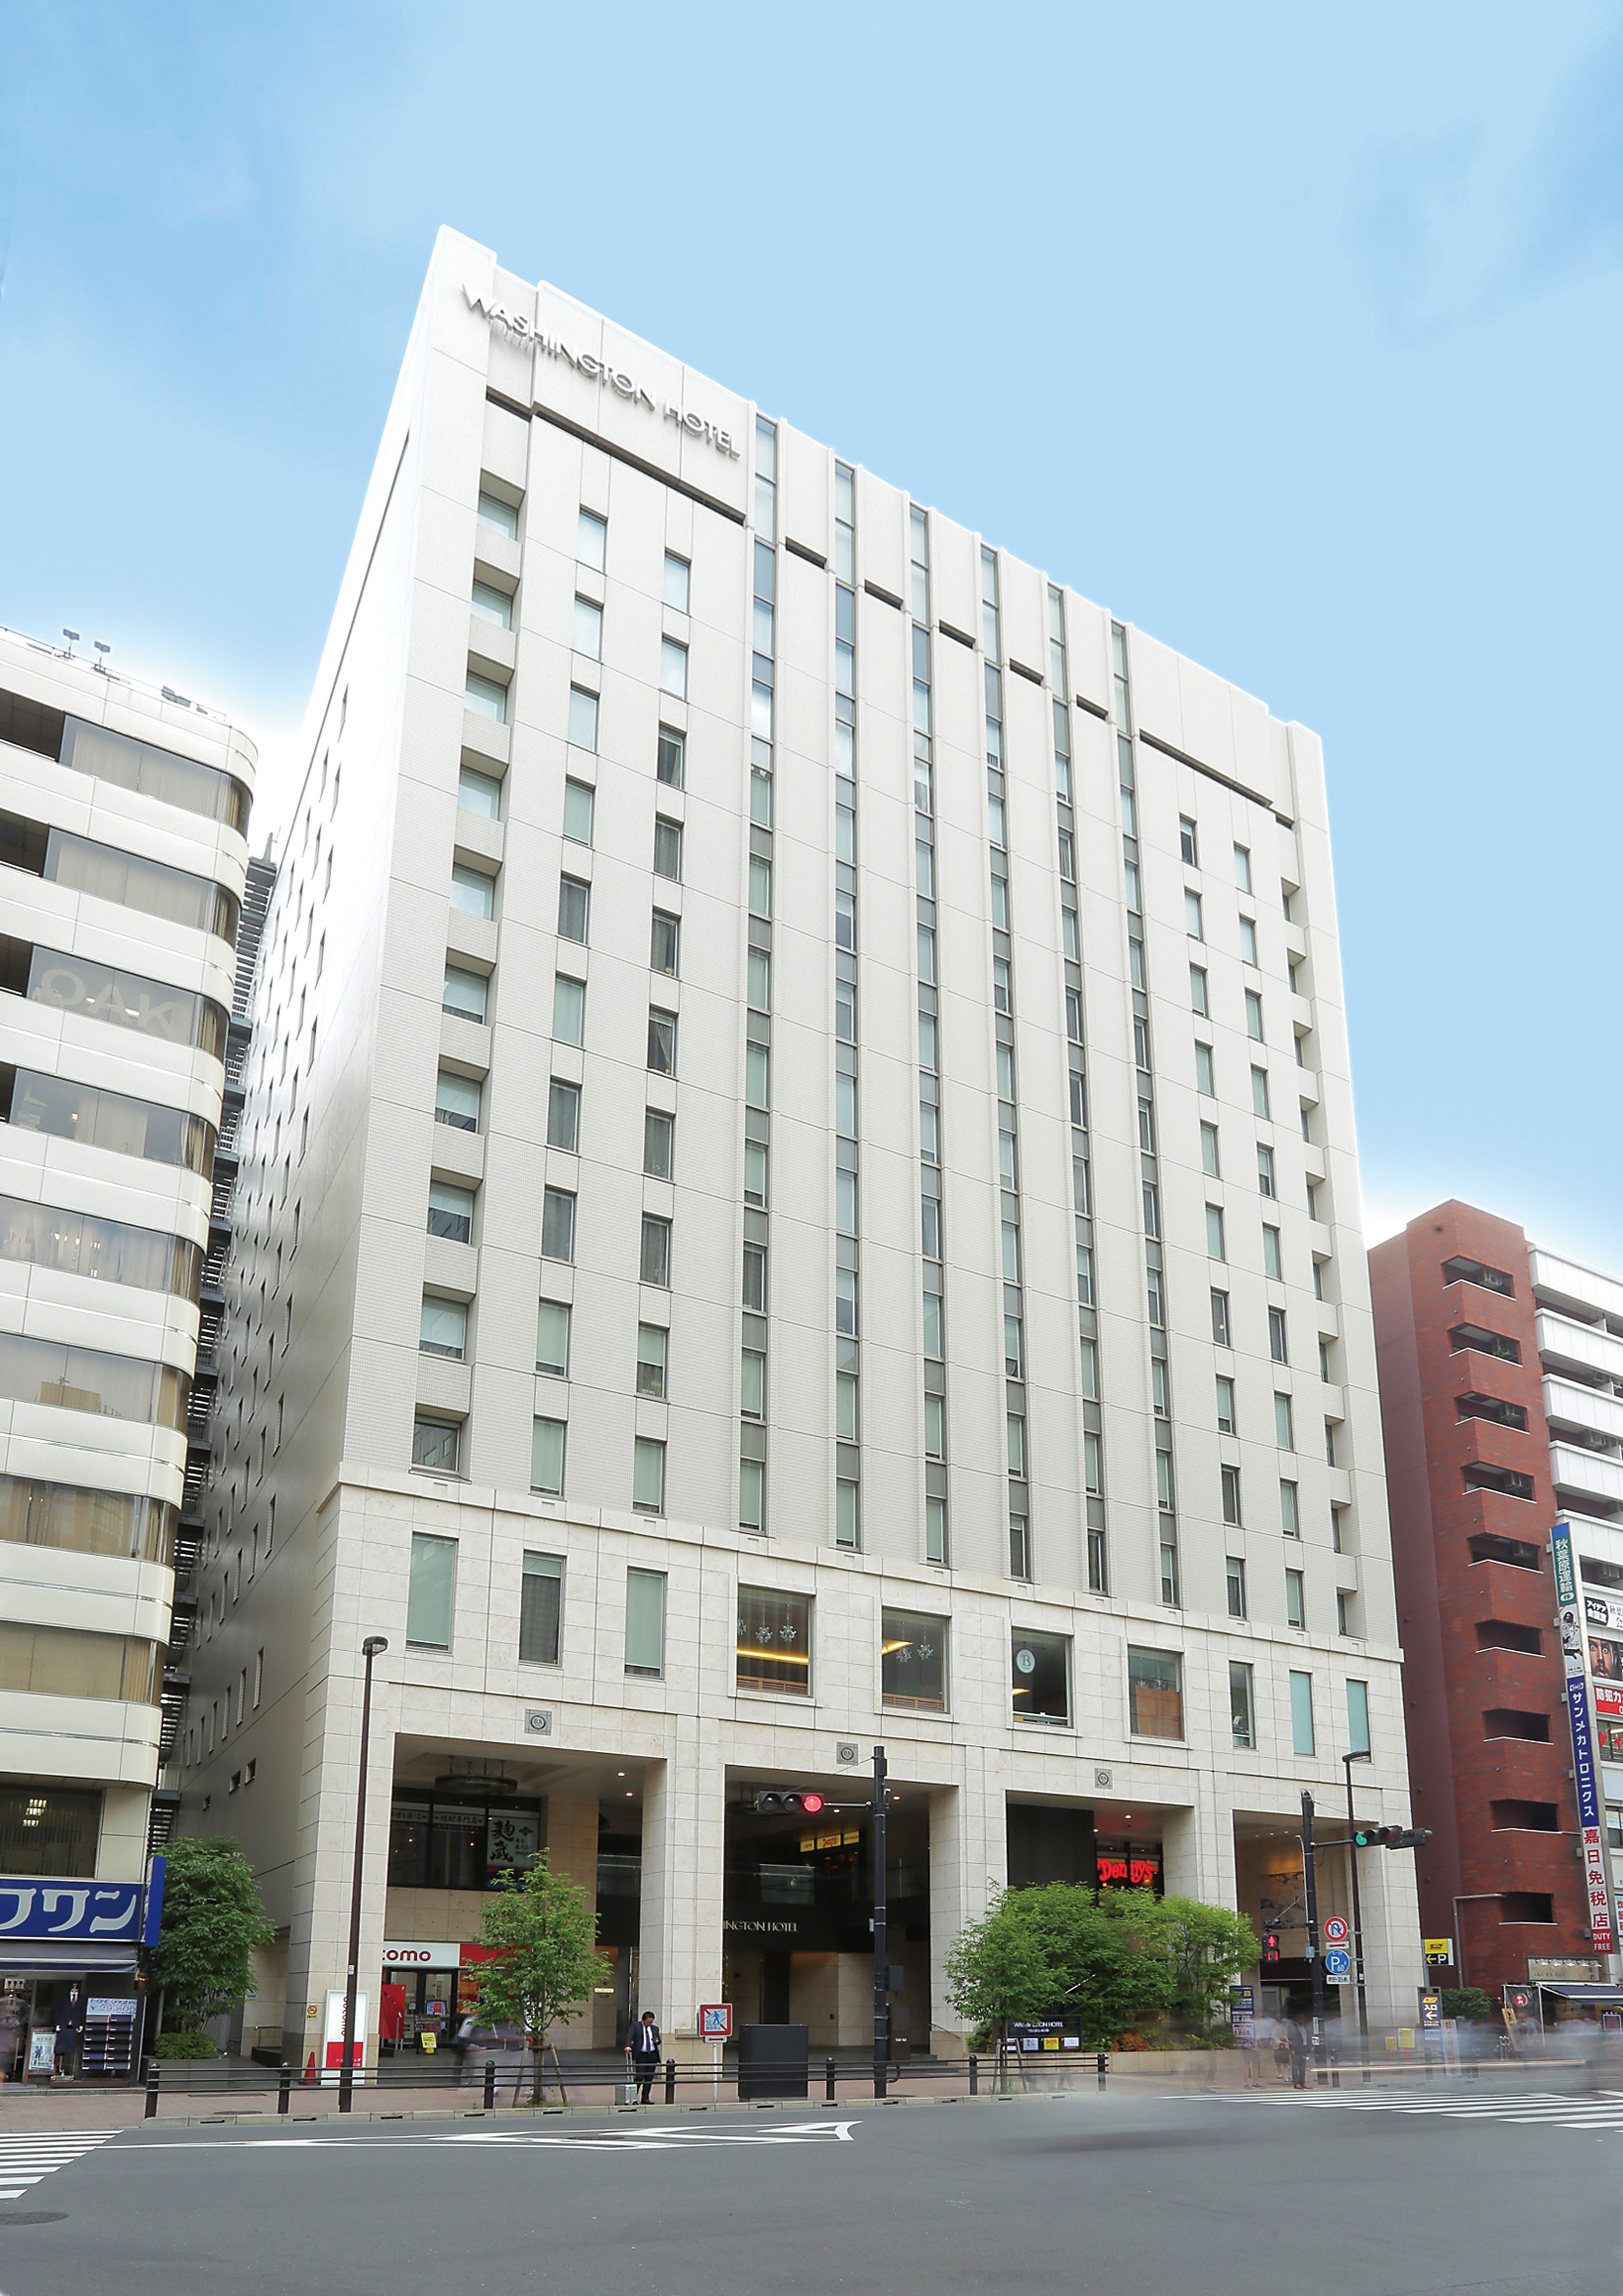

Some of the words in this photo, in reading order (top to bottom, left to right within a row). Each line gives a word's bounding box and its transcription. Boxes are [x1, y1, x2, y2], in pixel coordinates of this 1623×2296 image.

[462, 283, 658, 411] WASHINGTON
[664, 398, 741, 460] HOTEL
[1572, 1692, 1594, 1817] サンメカトロニクス
[1097, 1859, 1157, 1883] Denny's
[1584, 1829, 1608, 1928] 嘉日免税店
[768, 1921, 799, 1932] HOTEL
[1331, 1956, 1340, 1971] P
[1438, 1954, 1447, 1964] P
